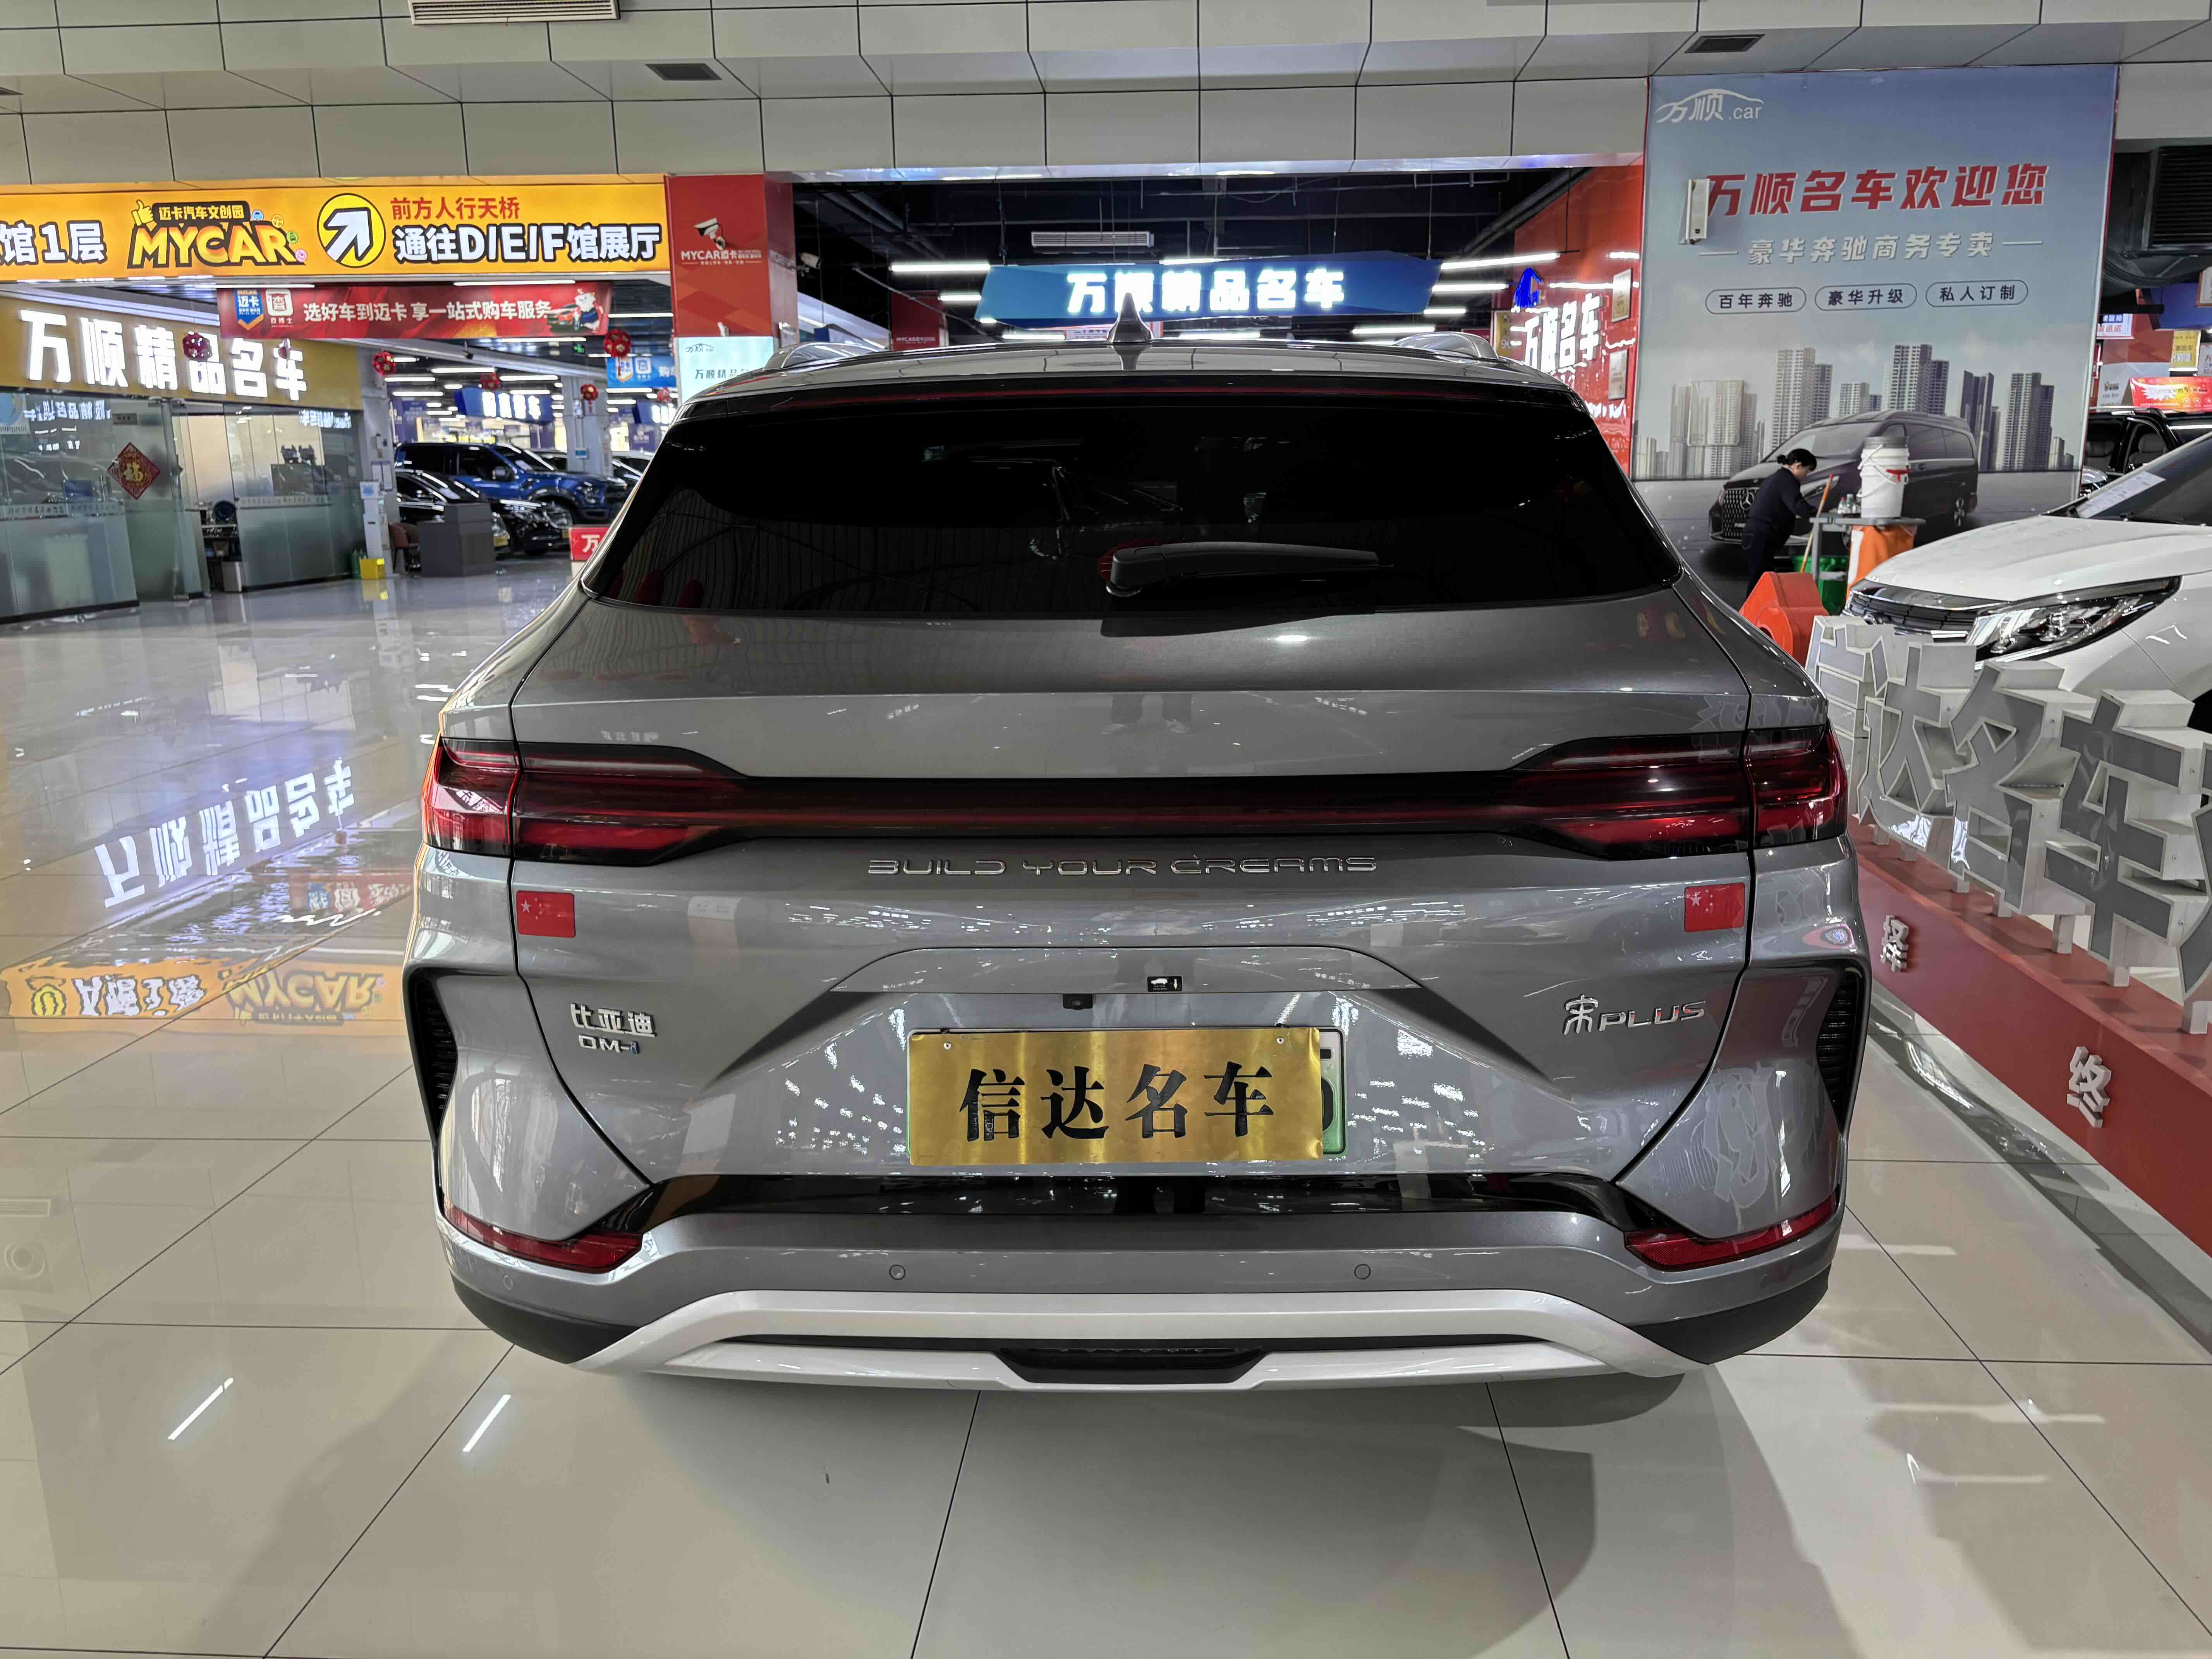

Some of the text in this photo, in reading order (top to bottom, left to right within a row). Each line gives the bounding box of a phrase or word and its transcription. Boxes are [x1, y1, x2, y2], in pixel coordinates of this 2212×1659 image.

[1707, 163, 2049, 217] 万顺名车欢迎您
[159, 205, 244, 220] 迈卡汽车文创园
[391, 196, 520, 220] 前方人行天桥
[0, 222, 105, 263] 馆1层
[132, 225, 297, 265] MYCAR
[1748, 232, 1994, 264] 豪华奔驰商务专卖
[1719, 292, 1793, 309] 百年奔驰
[1827, 289, 1904, 306] 豪华升级
[1939, 285, 2015, 302] 私人订制
[304, 300, 551, 323] 选好车到迈卡 享一站式购车服务
[20, 310, 307, 401] 万顺精品名车
[868, 859, 1006, 876] BUILD
[1023, 859, 1156, 876] YOUR
[570, 1002, 658, 1038] 比亚迪
[578, 1034, 640, 1055] DM-i
[958, 1060, 1274, 1142] 信达名车
